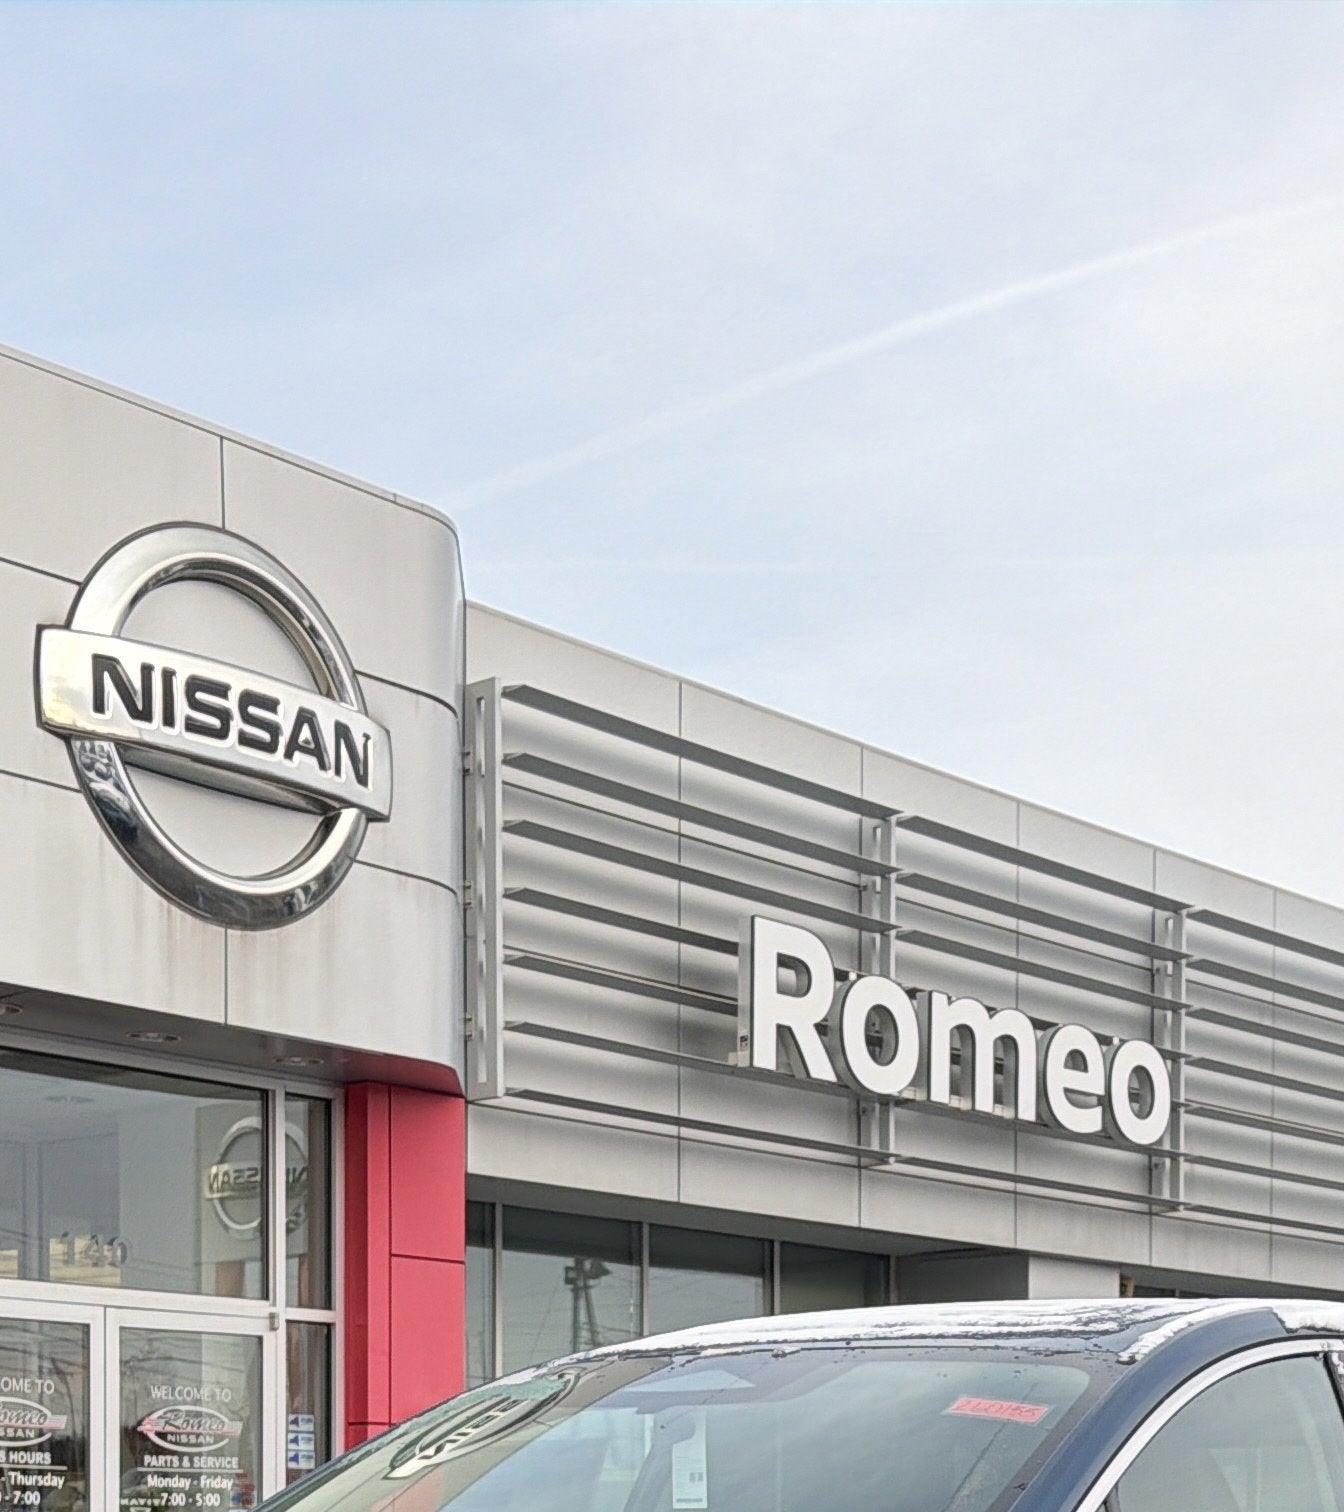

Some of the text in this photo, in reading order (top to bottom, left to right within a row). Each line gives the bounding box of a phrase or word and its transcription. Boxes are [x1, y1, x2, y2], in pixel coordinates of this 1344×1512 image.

[91, 653, 373, 789] NISSAN
[749, 914, 1171, 1146] Romeo
[36, 1379, 54, 1394] TO
[151, 1385, 231, 1402] WELCOME TO
[159, 1409, 225, 1430] Romeo
[167, 1434, 214, 1443] NISSAN
[9, 1451, 51, 1464] HOURS
[144, 1455, 239, 1469] PARTS & SERVICE
[9, 1472, 65, 1489] Thursday
[147, 1475, 191, 1490] Monday
[200, 1476, 233, 1491] Friday
[13, 1491, 41, 1505] 7:00
[161, 1492, 186, 1506] 7:00
[196, 1494, 220, 1506] 5:00
